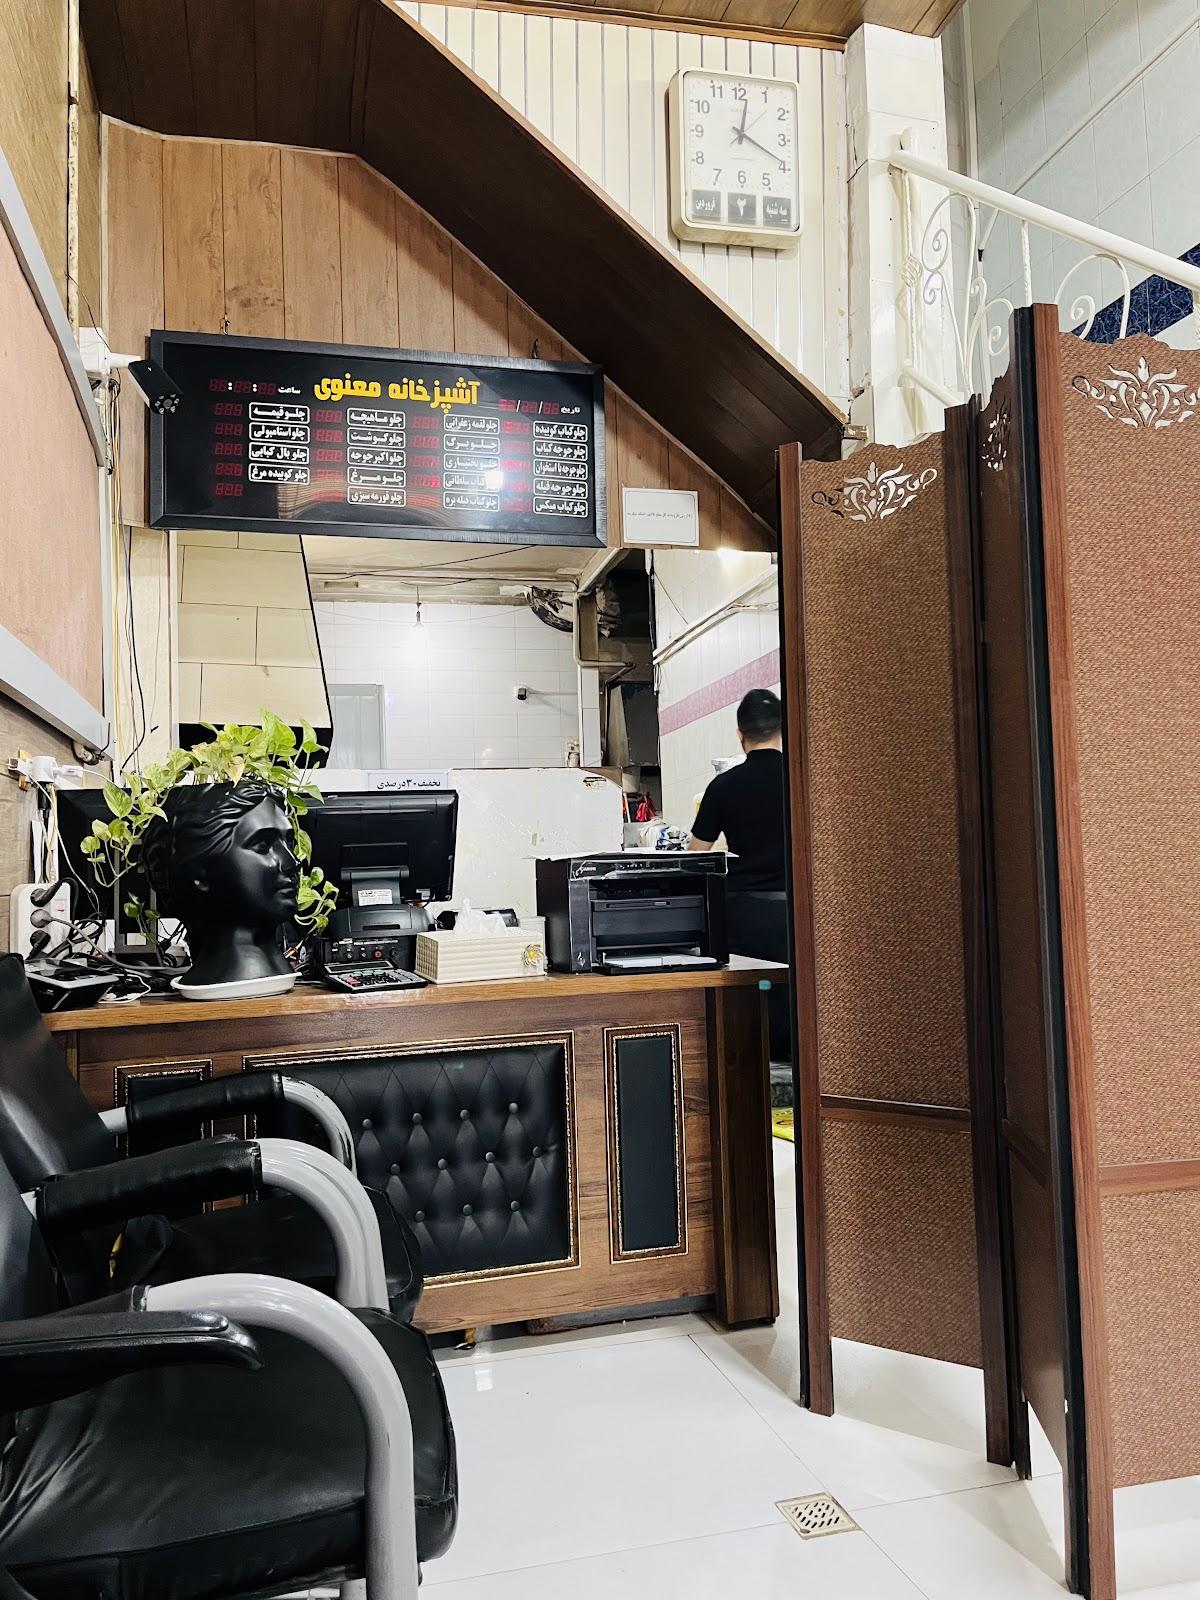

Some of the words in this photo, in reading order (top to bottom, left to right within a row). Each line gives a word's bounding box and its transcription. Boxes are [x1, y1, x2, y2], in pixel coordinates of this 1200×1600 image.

[710, 85, 723, 98] 11
[732, 88, 746, 100] 12
[762, 90, 768, 103] 1
[695, 101, 710, 113] 10
[778, 108, 786, 121] 2
[695, 125, 704, 137] 9
[778, 134, 786, 146] 3
[696, 152, 704, 164] 8
[778, 160, 786, 173] 4
[713, 168, 722, 182] 7
[738, 171, 746, 184] 6
[762, 173, 770, 186] 5
[278, 386, 300, 394] ساعت
[314, 373, 381, 401] معنوی
[253, 407, 284, 419] قیمه
[561, 406, 580, 414] تاریخ
[351, 412, 387, 424] ماهیچه
[446, 417, 471, 430] زعفرانی
[254, 425, 291, 438] استامبولی
[536, 425, 558, 437] کوبیده
[558, 426, 573, 438] کباب
[252, 446, 275, 458] کبابی
[276, 447, 290, 459] بال
[536, 443, 552, 455] کباب
[553, 446, 572, 457] جوجه
[351, 451, 373, 463] جوجه
[374, 452, 388, 464] اکبر
[252, 466, 267, 479] مرغ
[536, 461, 557, 474] استخوان
[268, 469, 293, 480] کوبیده
[351, 469, 380, 482] مرغ
[446, 475, 470, 487] سلطانی
[536, 481, 550, 492] فیله
[551, 483, 572, 495] جوجه
[352, 491, 370, 502] سبزی
[446, 497, 456, 506] بره
[536, 500, 556, 512] میکس
[557, 501, 573, 513] کباب
